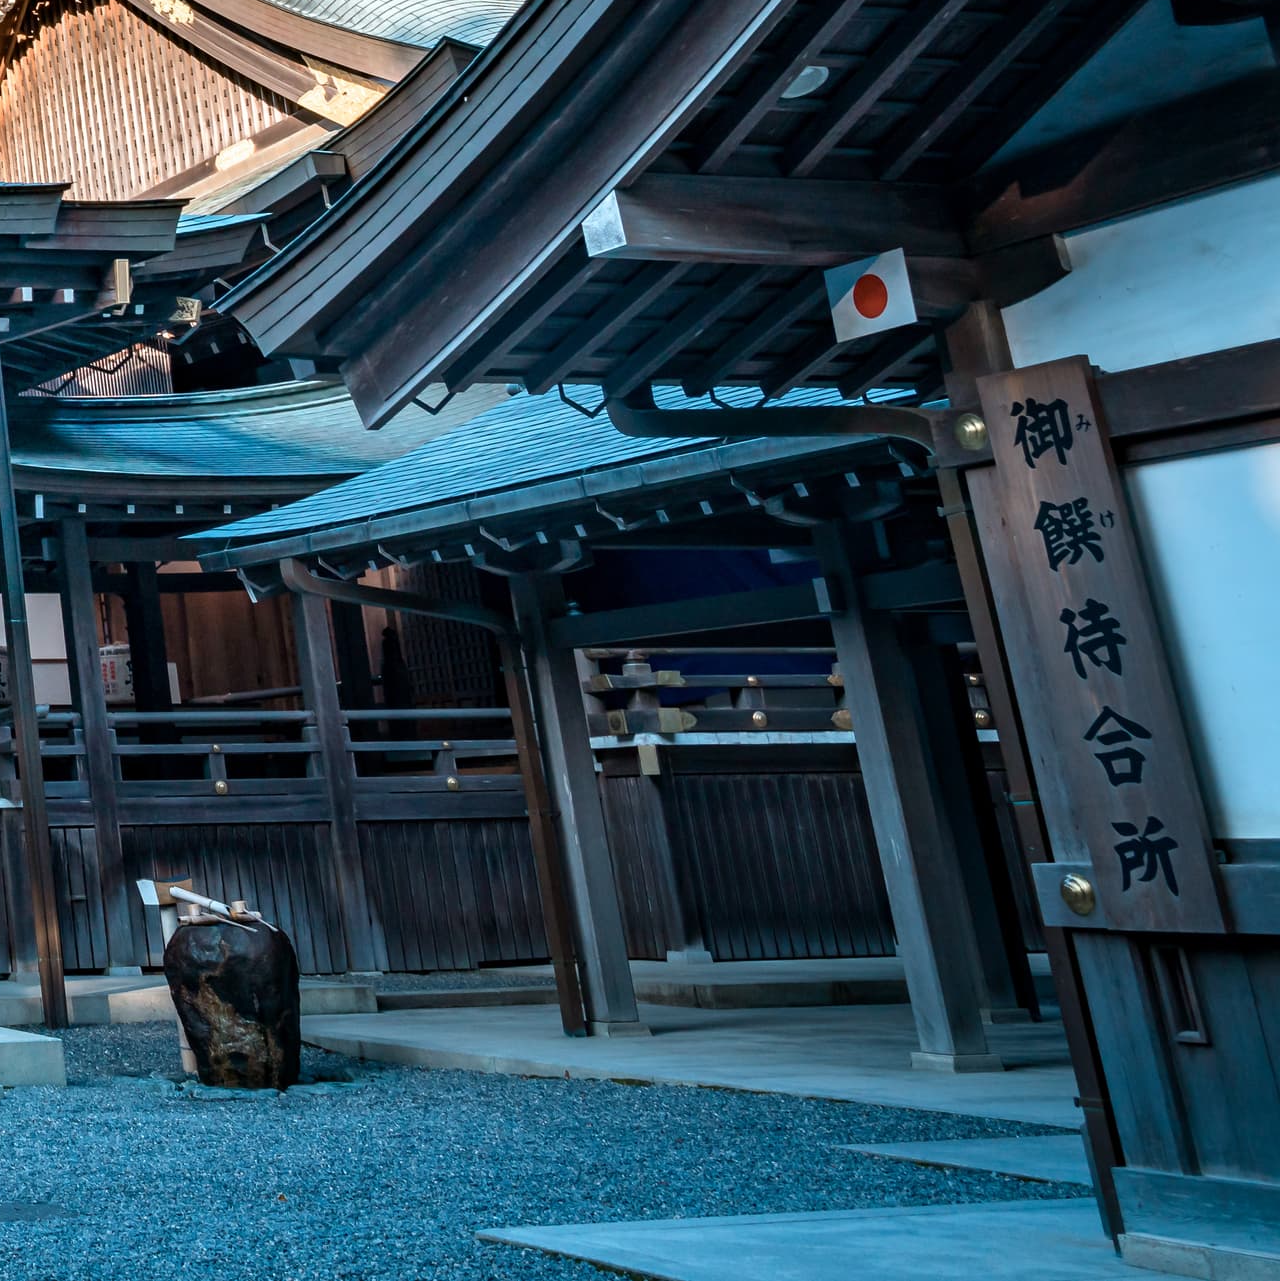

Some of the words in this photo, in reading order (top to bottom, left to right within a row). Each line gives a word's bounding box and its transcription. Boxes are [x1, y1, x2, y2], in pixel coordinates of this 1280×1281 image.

[1075, 413, 1092, 433] み
[1099, 511, 1116, 529] け
[1011, 397, 1180, 897] 御饌待合所
